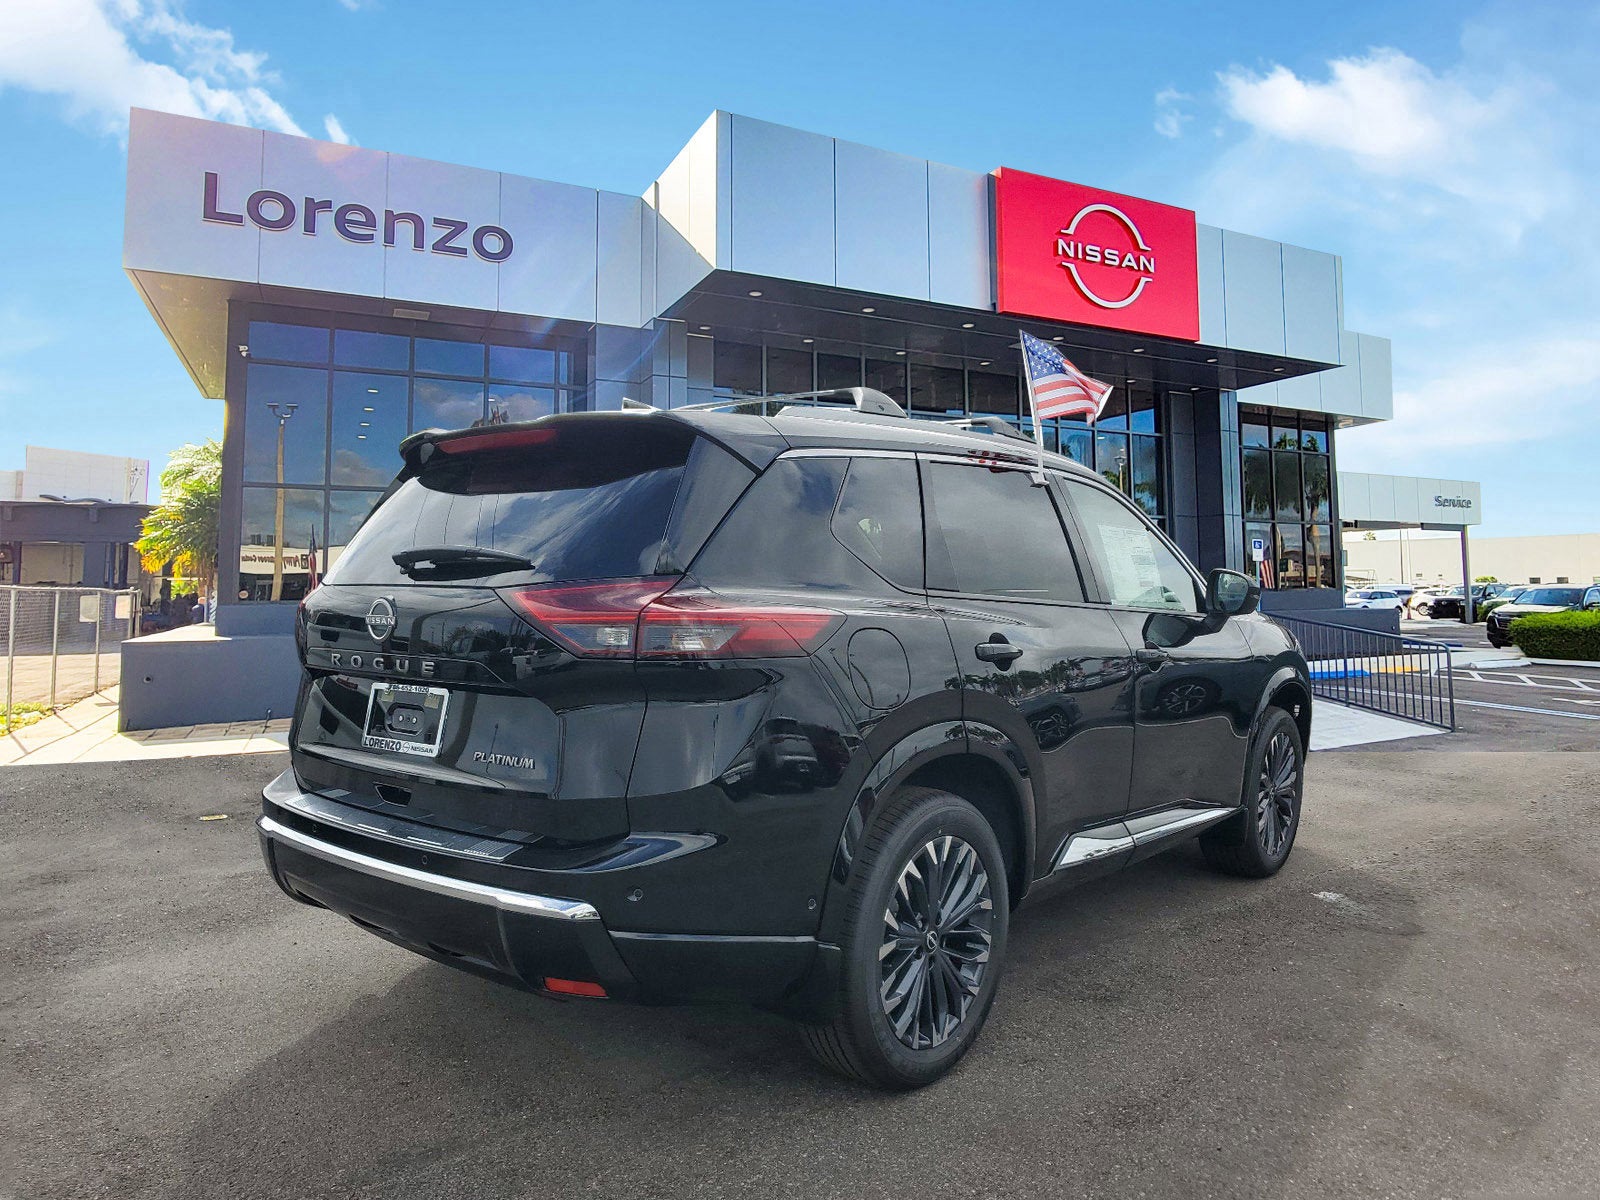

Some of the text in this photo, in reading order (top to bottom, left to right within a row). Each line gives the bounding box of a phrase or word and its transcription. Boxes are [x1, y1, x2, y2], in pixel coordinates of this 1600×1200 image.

[202, 171, 514, 263] Lorenzo
[1057, 238, 1155, 273] NISSAN
[1434, 495, 1472, 509] Service
[365, 615, 396, 626] NISSAN
[331, 653, 435, 676] ROGUE
[362, 736, 402, 752] LORENZO
[472, 751, 536, 769] PLATINUM
